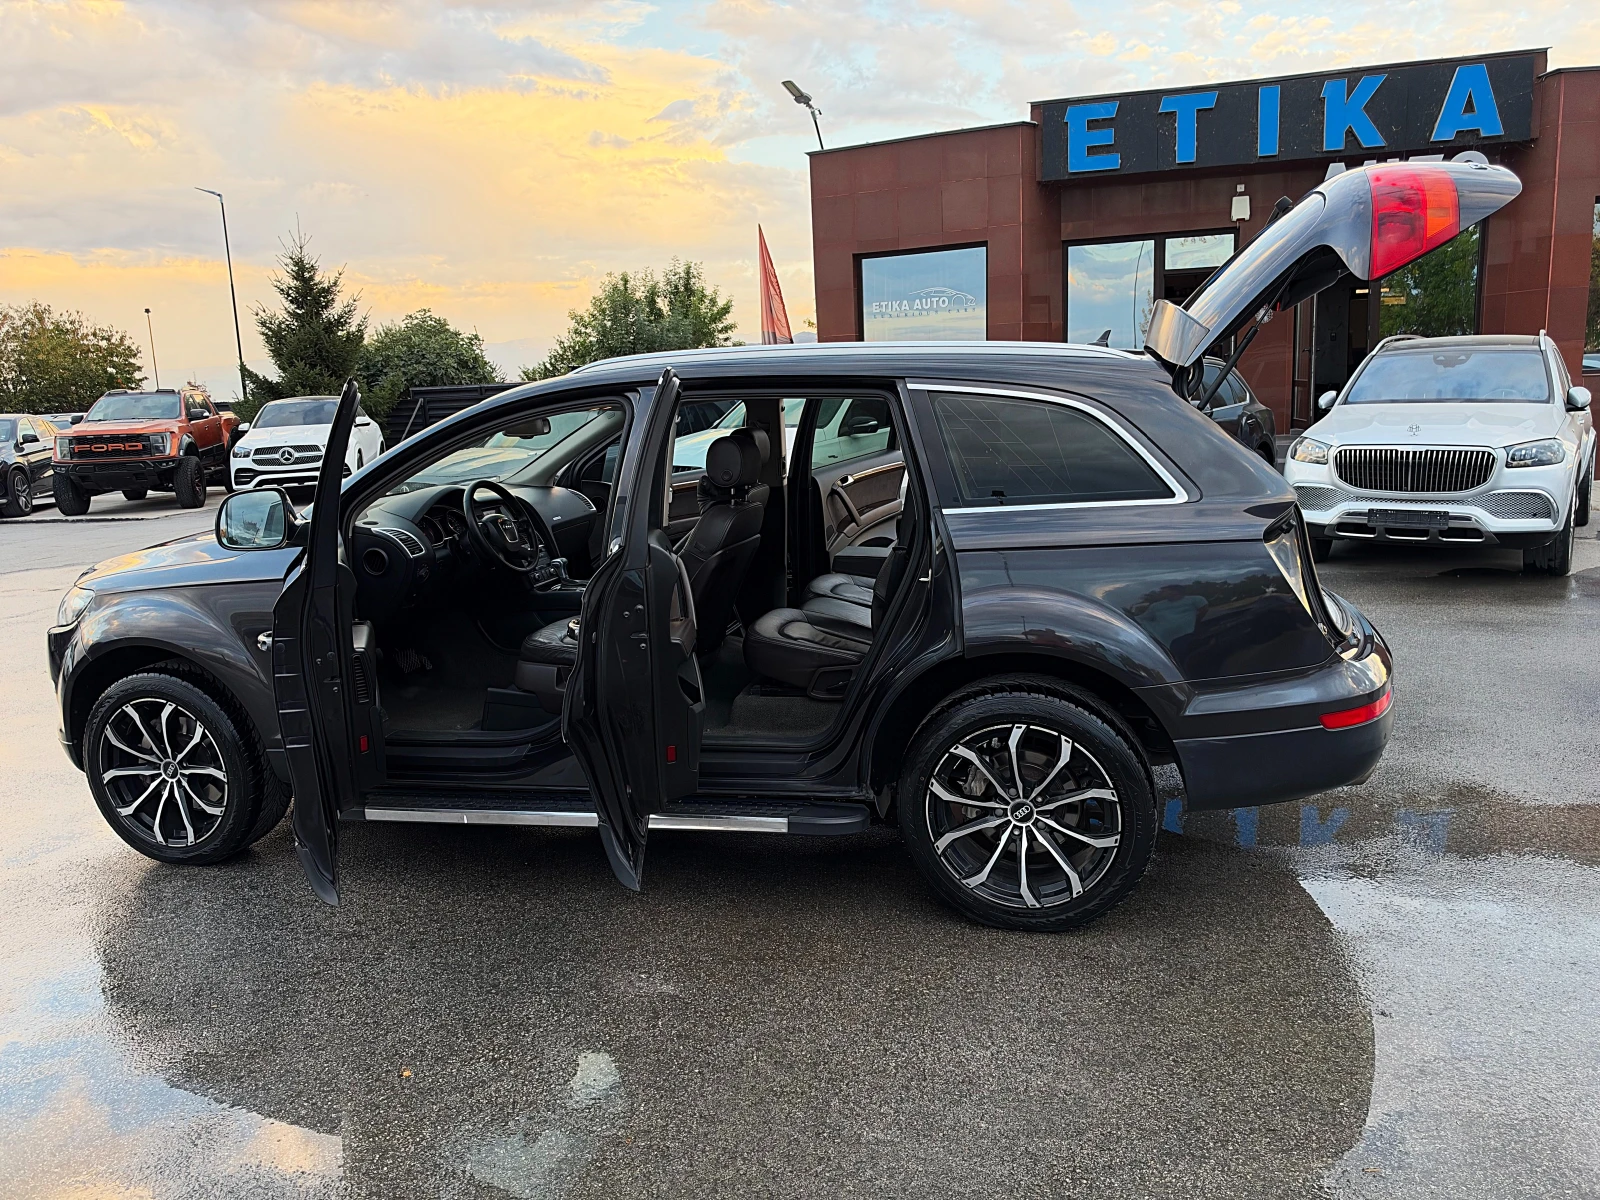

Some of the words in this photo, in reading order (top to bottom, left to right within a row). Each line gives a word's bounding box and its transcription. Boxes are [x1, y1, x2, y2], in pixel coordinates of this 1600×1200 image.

[1064, 63, 1505, 173] ETIKA
[872, 300, 910, 312] ETIKA
[913, 296, 949, 310] AUTO
[74, 442, 143, 453] FORD
